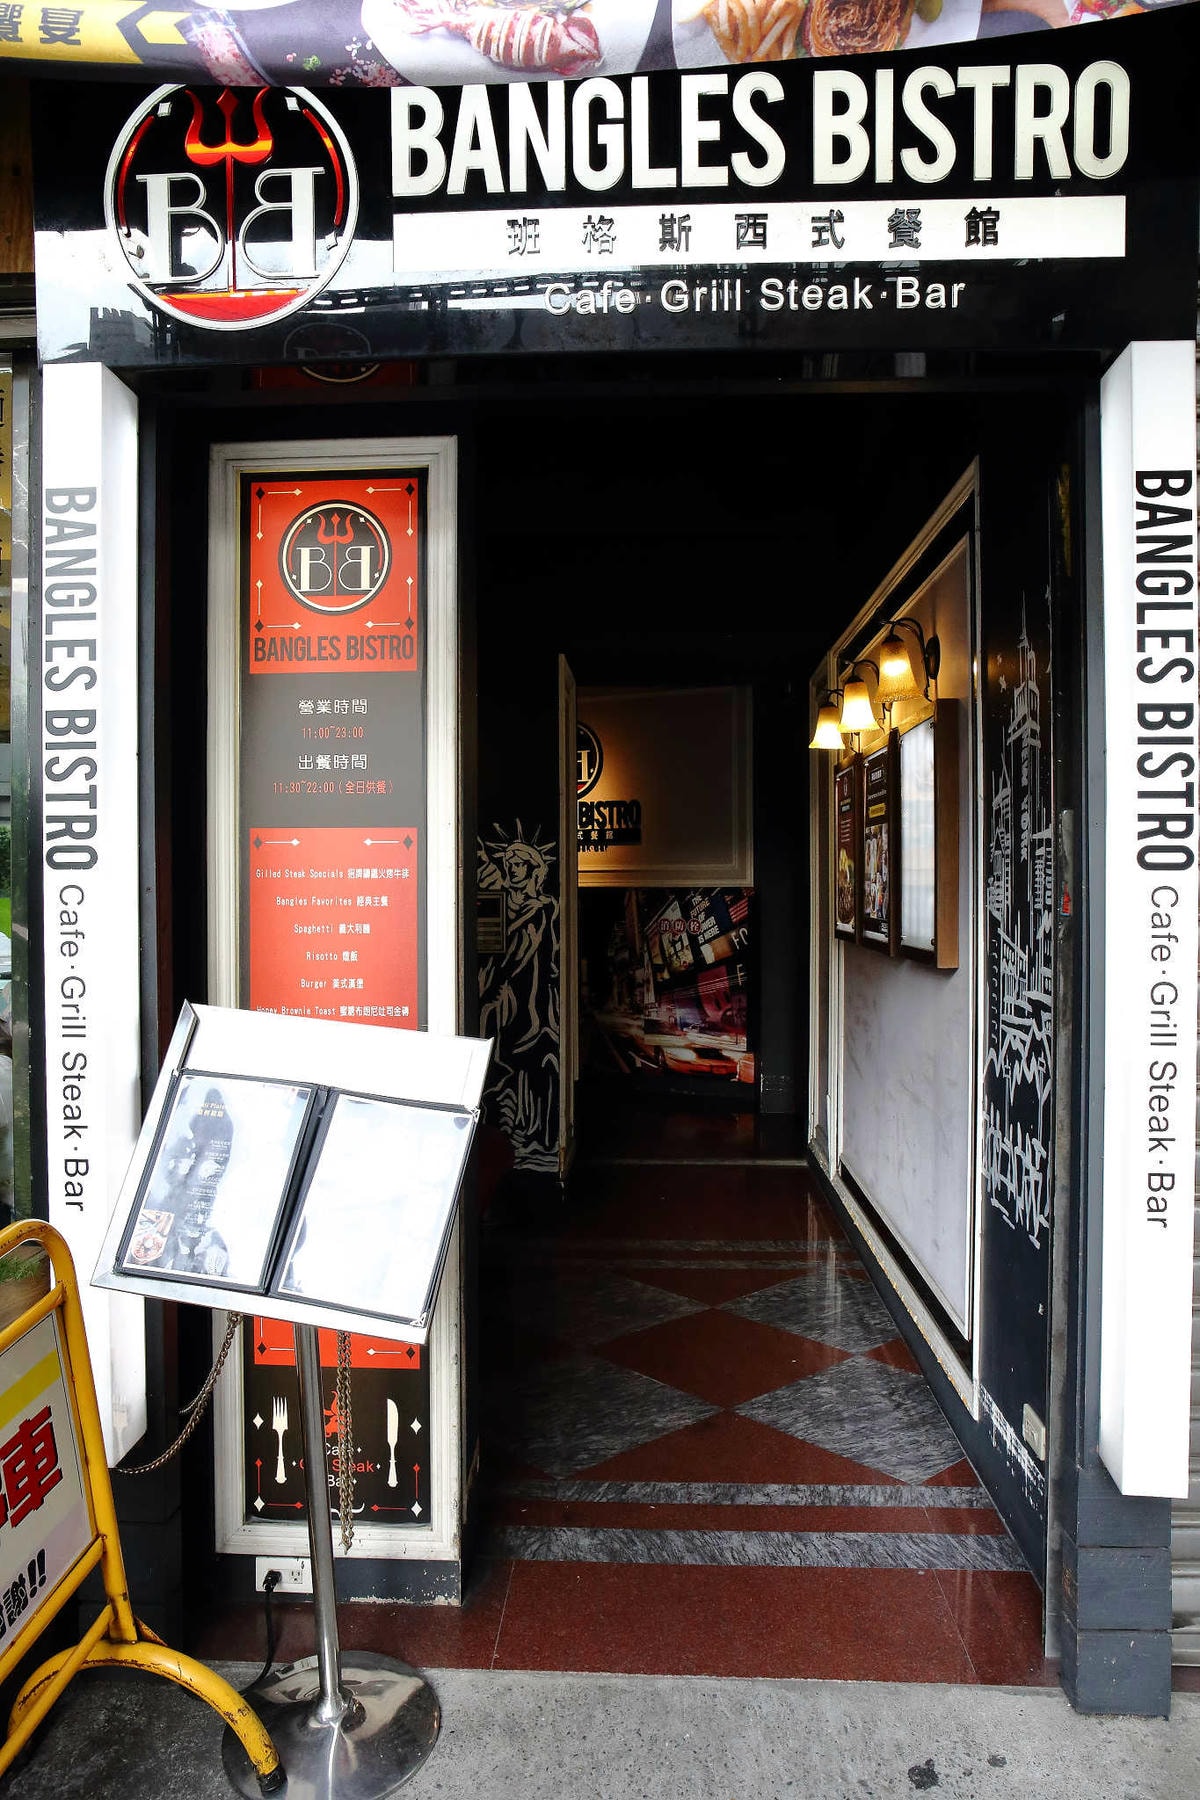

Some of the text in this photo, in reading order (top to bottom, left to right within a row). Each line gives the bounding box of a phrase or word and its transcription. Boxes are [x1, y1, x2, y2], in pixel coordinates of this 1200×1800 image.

[391, 60, 1131, 198] BANGLES BISTRO
[505, 206, 1000, 257] 班格斯西式餐館
[254, 633, 414, 662] BANGLES BISTRO
[45, 487, 98, 871] BANGLES BISTRO
[1135, 470, 1195, 871] BANGLES BISTRO
[298, 698, 368, 715] 營業時間
[298, 754, 368, 770] 出餐時間
[294, 924, 333, 935] Spaghetti
[306, 952, 338, 961] Risotto
[301, 979, 327, 990] Burger
[314, 1005, 336, 1016] Toast
